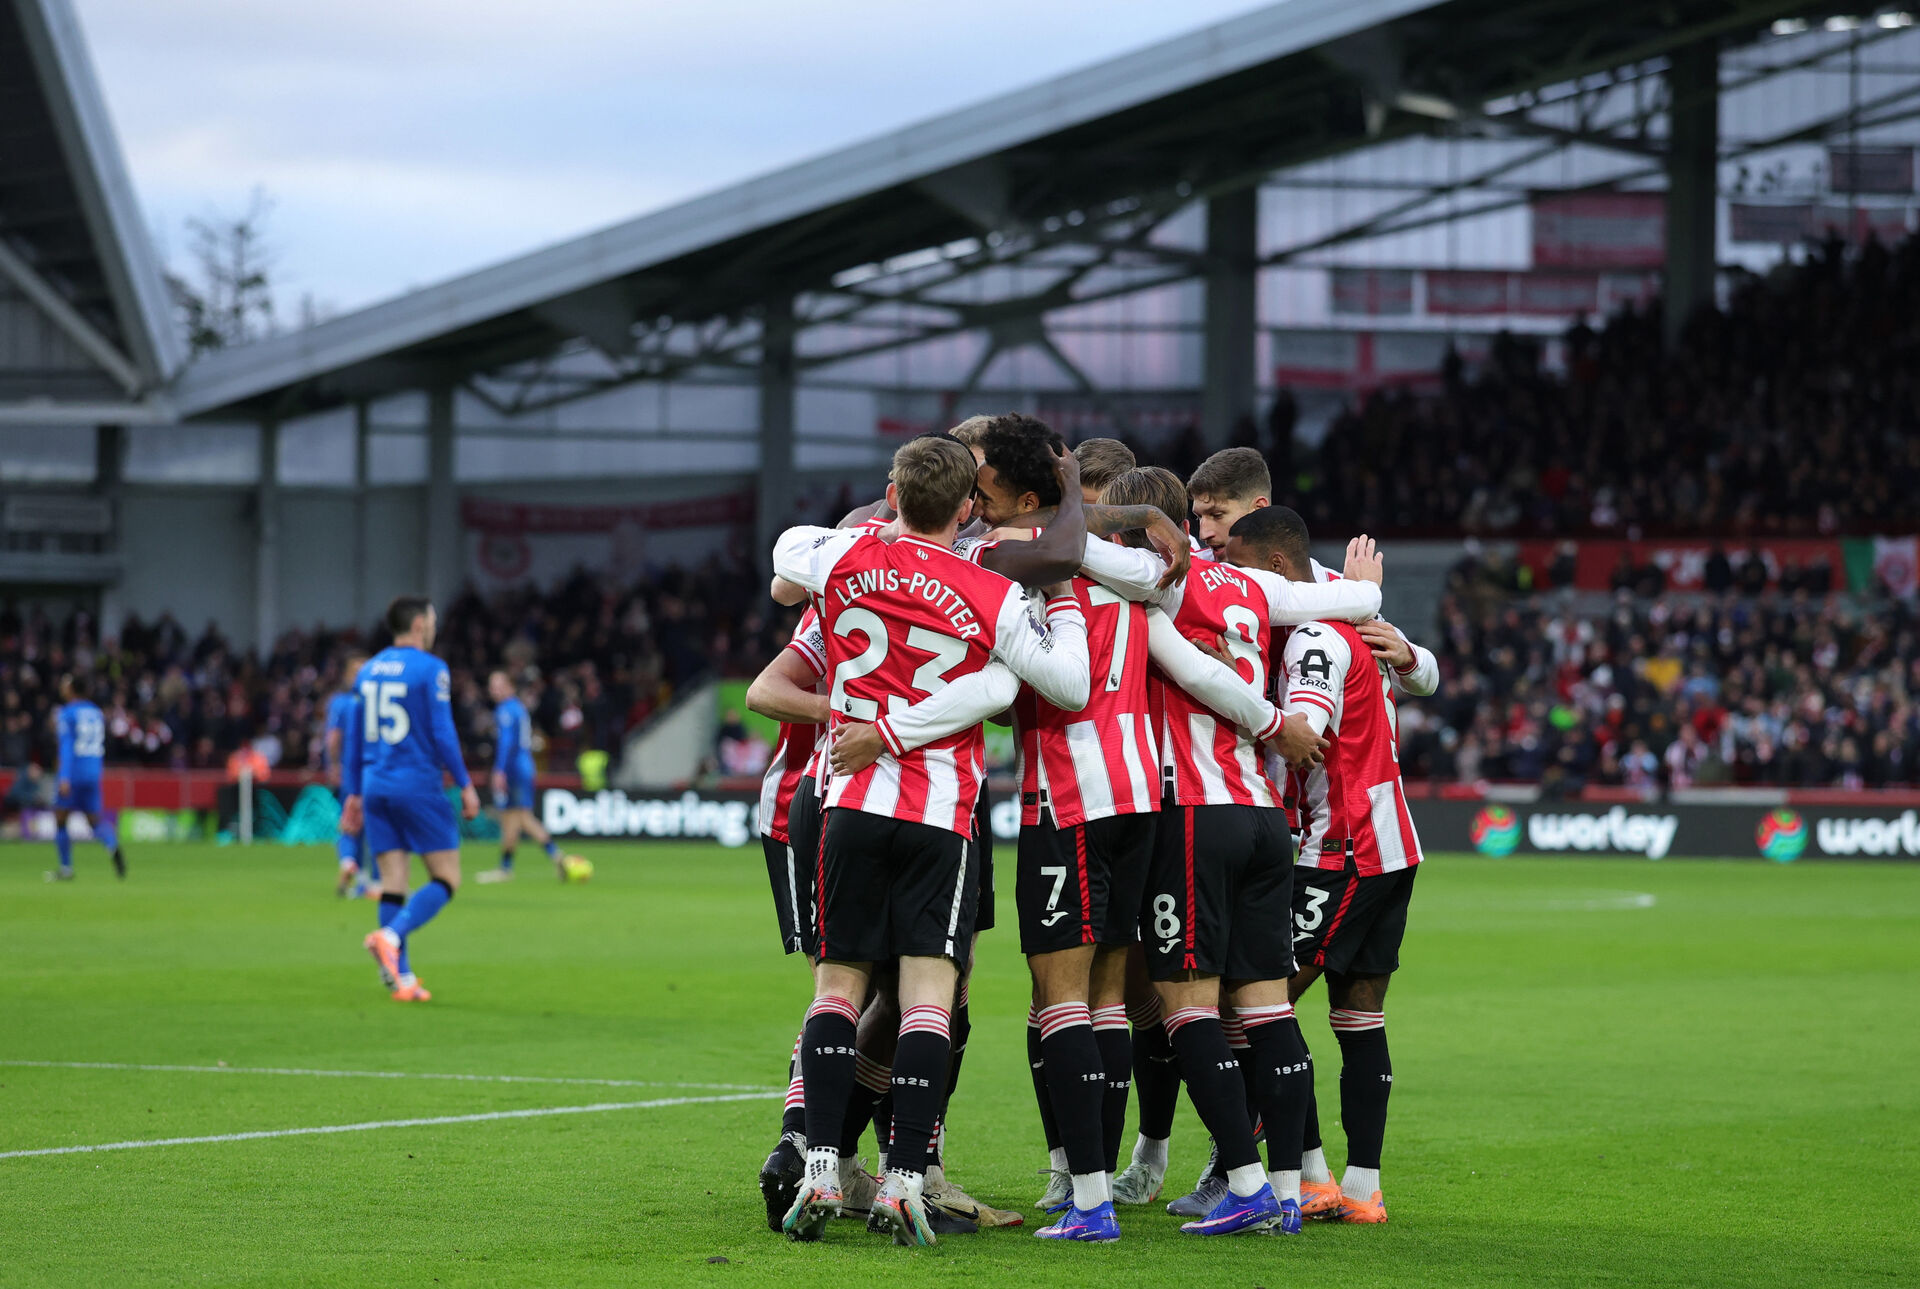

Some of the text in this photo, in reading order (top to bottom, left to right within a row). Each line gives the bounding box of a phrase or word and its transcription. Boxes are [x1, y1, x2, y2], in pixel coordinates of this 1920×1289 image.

[835, 568, 981, 640] LEWIS-POTTER
[830, 607, 970, 722] 23
[1086, 585, 1130, 692] 7
[1222, 604, 1265, 700] 8
[361, 680, 411, 746] 15
[542, 788, 750, 848] Delivering
[1528, 805, 1678, 860] worley
[1040, 866, 1067, 911] 7
[1153, 893, 1181, 939] 8
[1294, 886, 1330, 931] 3
[891, 1076, 929, 1088] 1925
[1274, 1062, 1308, 1075] 1925
